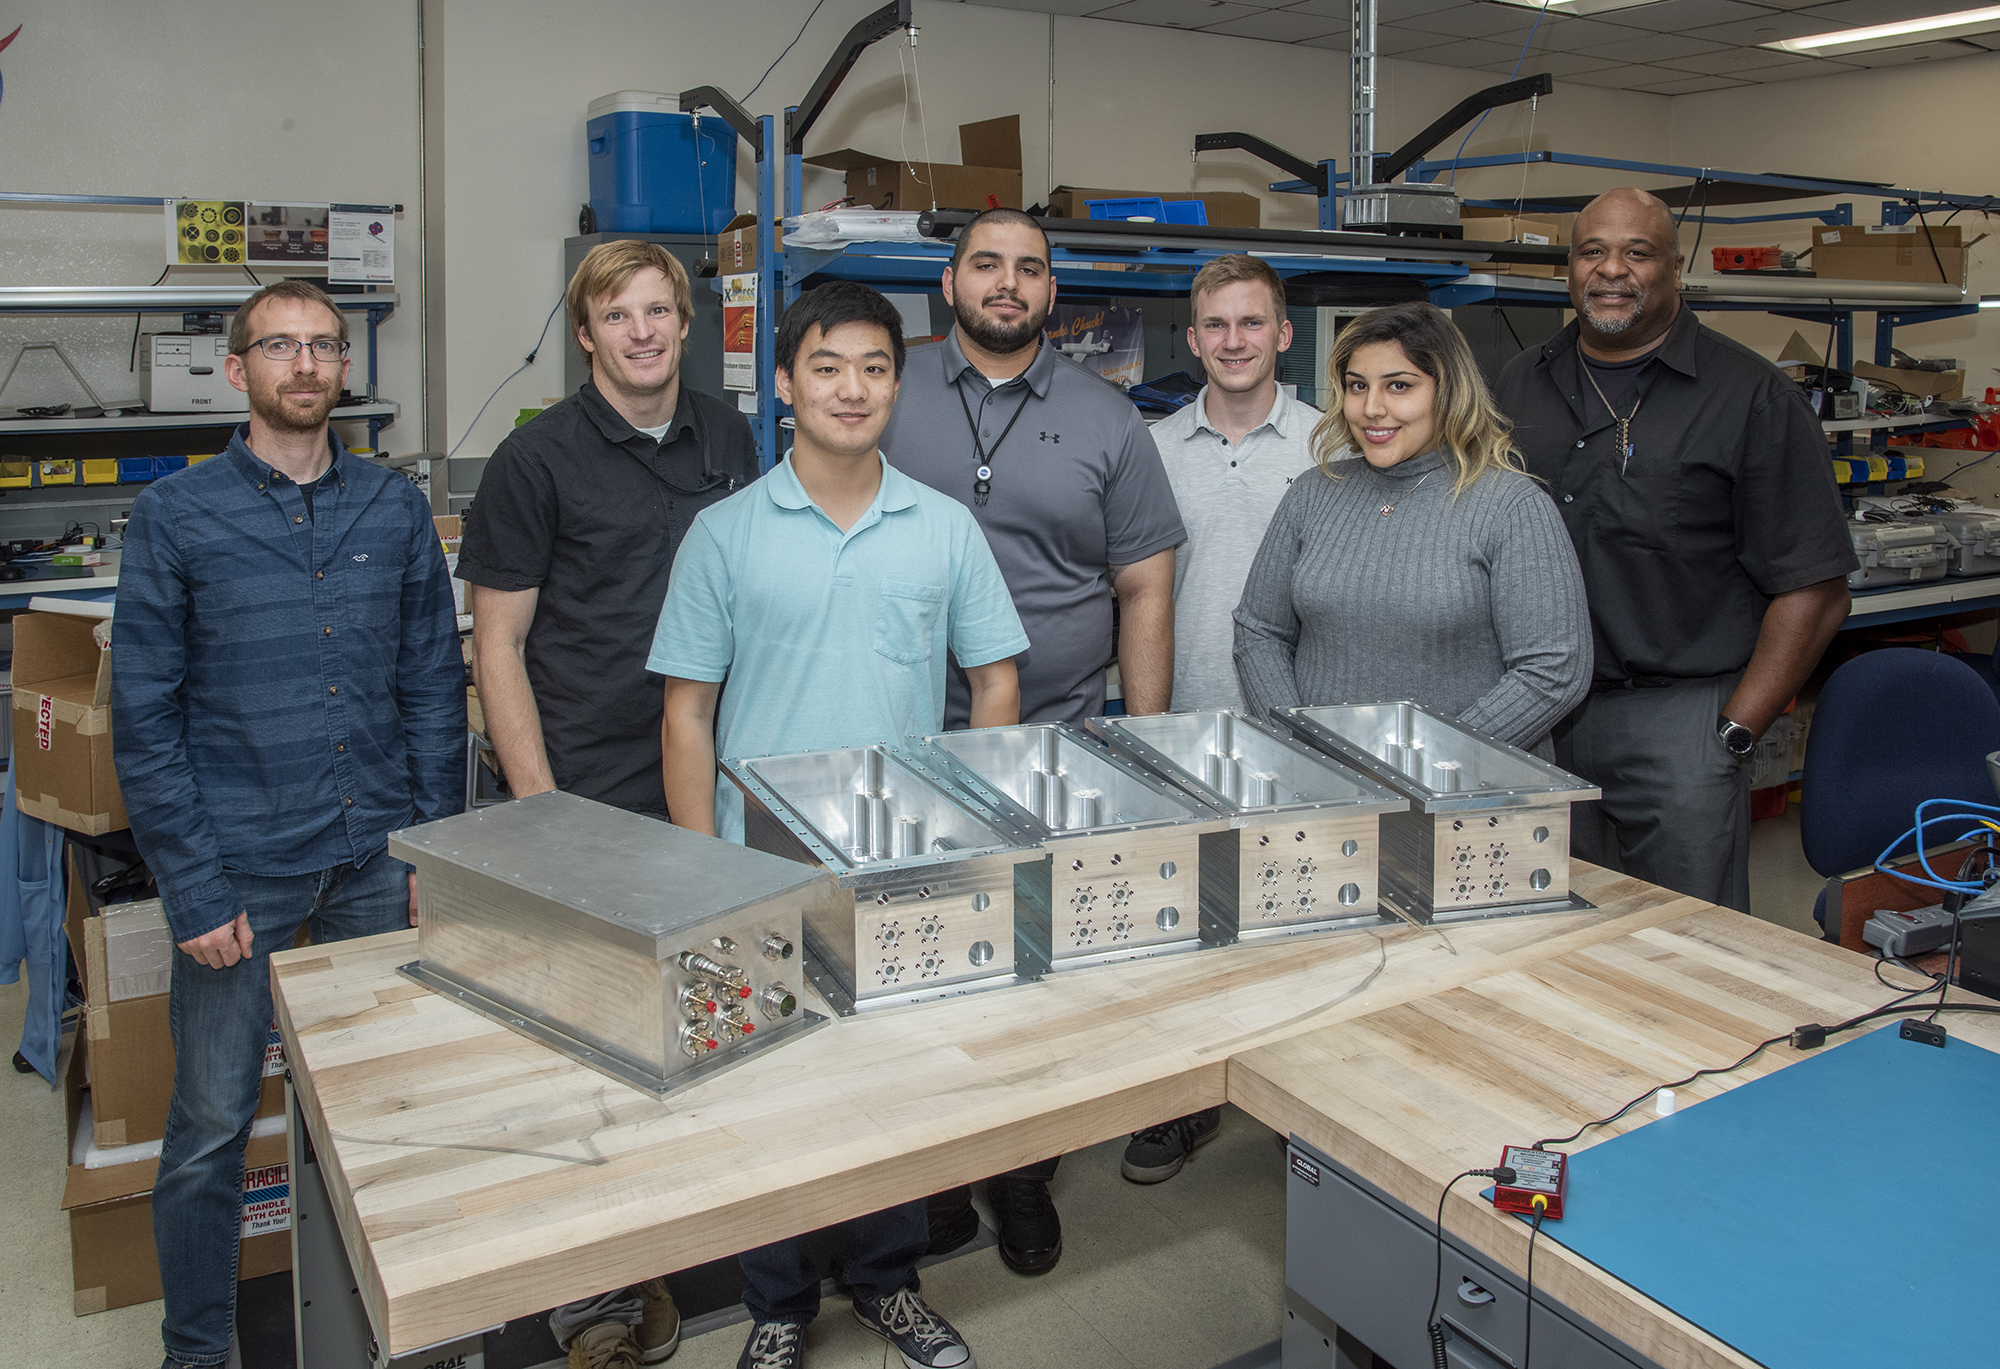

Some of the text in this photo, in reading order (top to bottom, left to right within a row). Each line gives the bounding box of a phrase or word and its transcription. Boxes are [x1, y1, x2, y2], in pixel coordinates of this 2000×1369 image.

[1072, 311, 1105, 336] Chuck!
[40, 696, 52, 750] ECTED
[242, 1164, 289, 1190] RAGIL
[1296, 1158, 1318, 1176] GLOBAL
[248, 1199, 286, 1213] HANDLE
[251, 1216, 287, 1230] Thank You!
